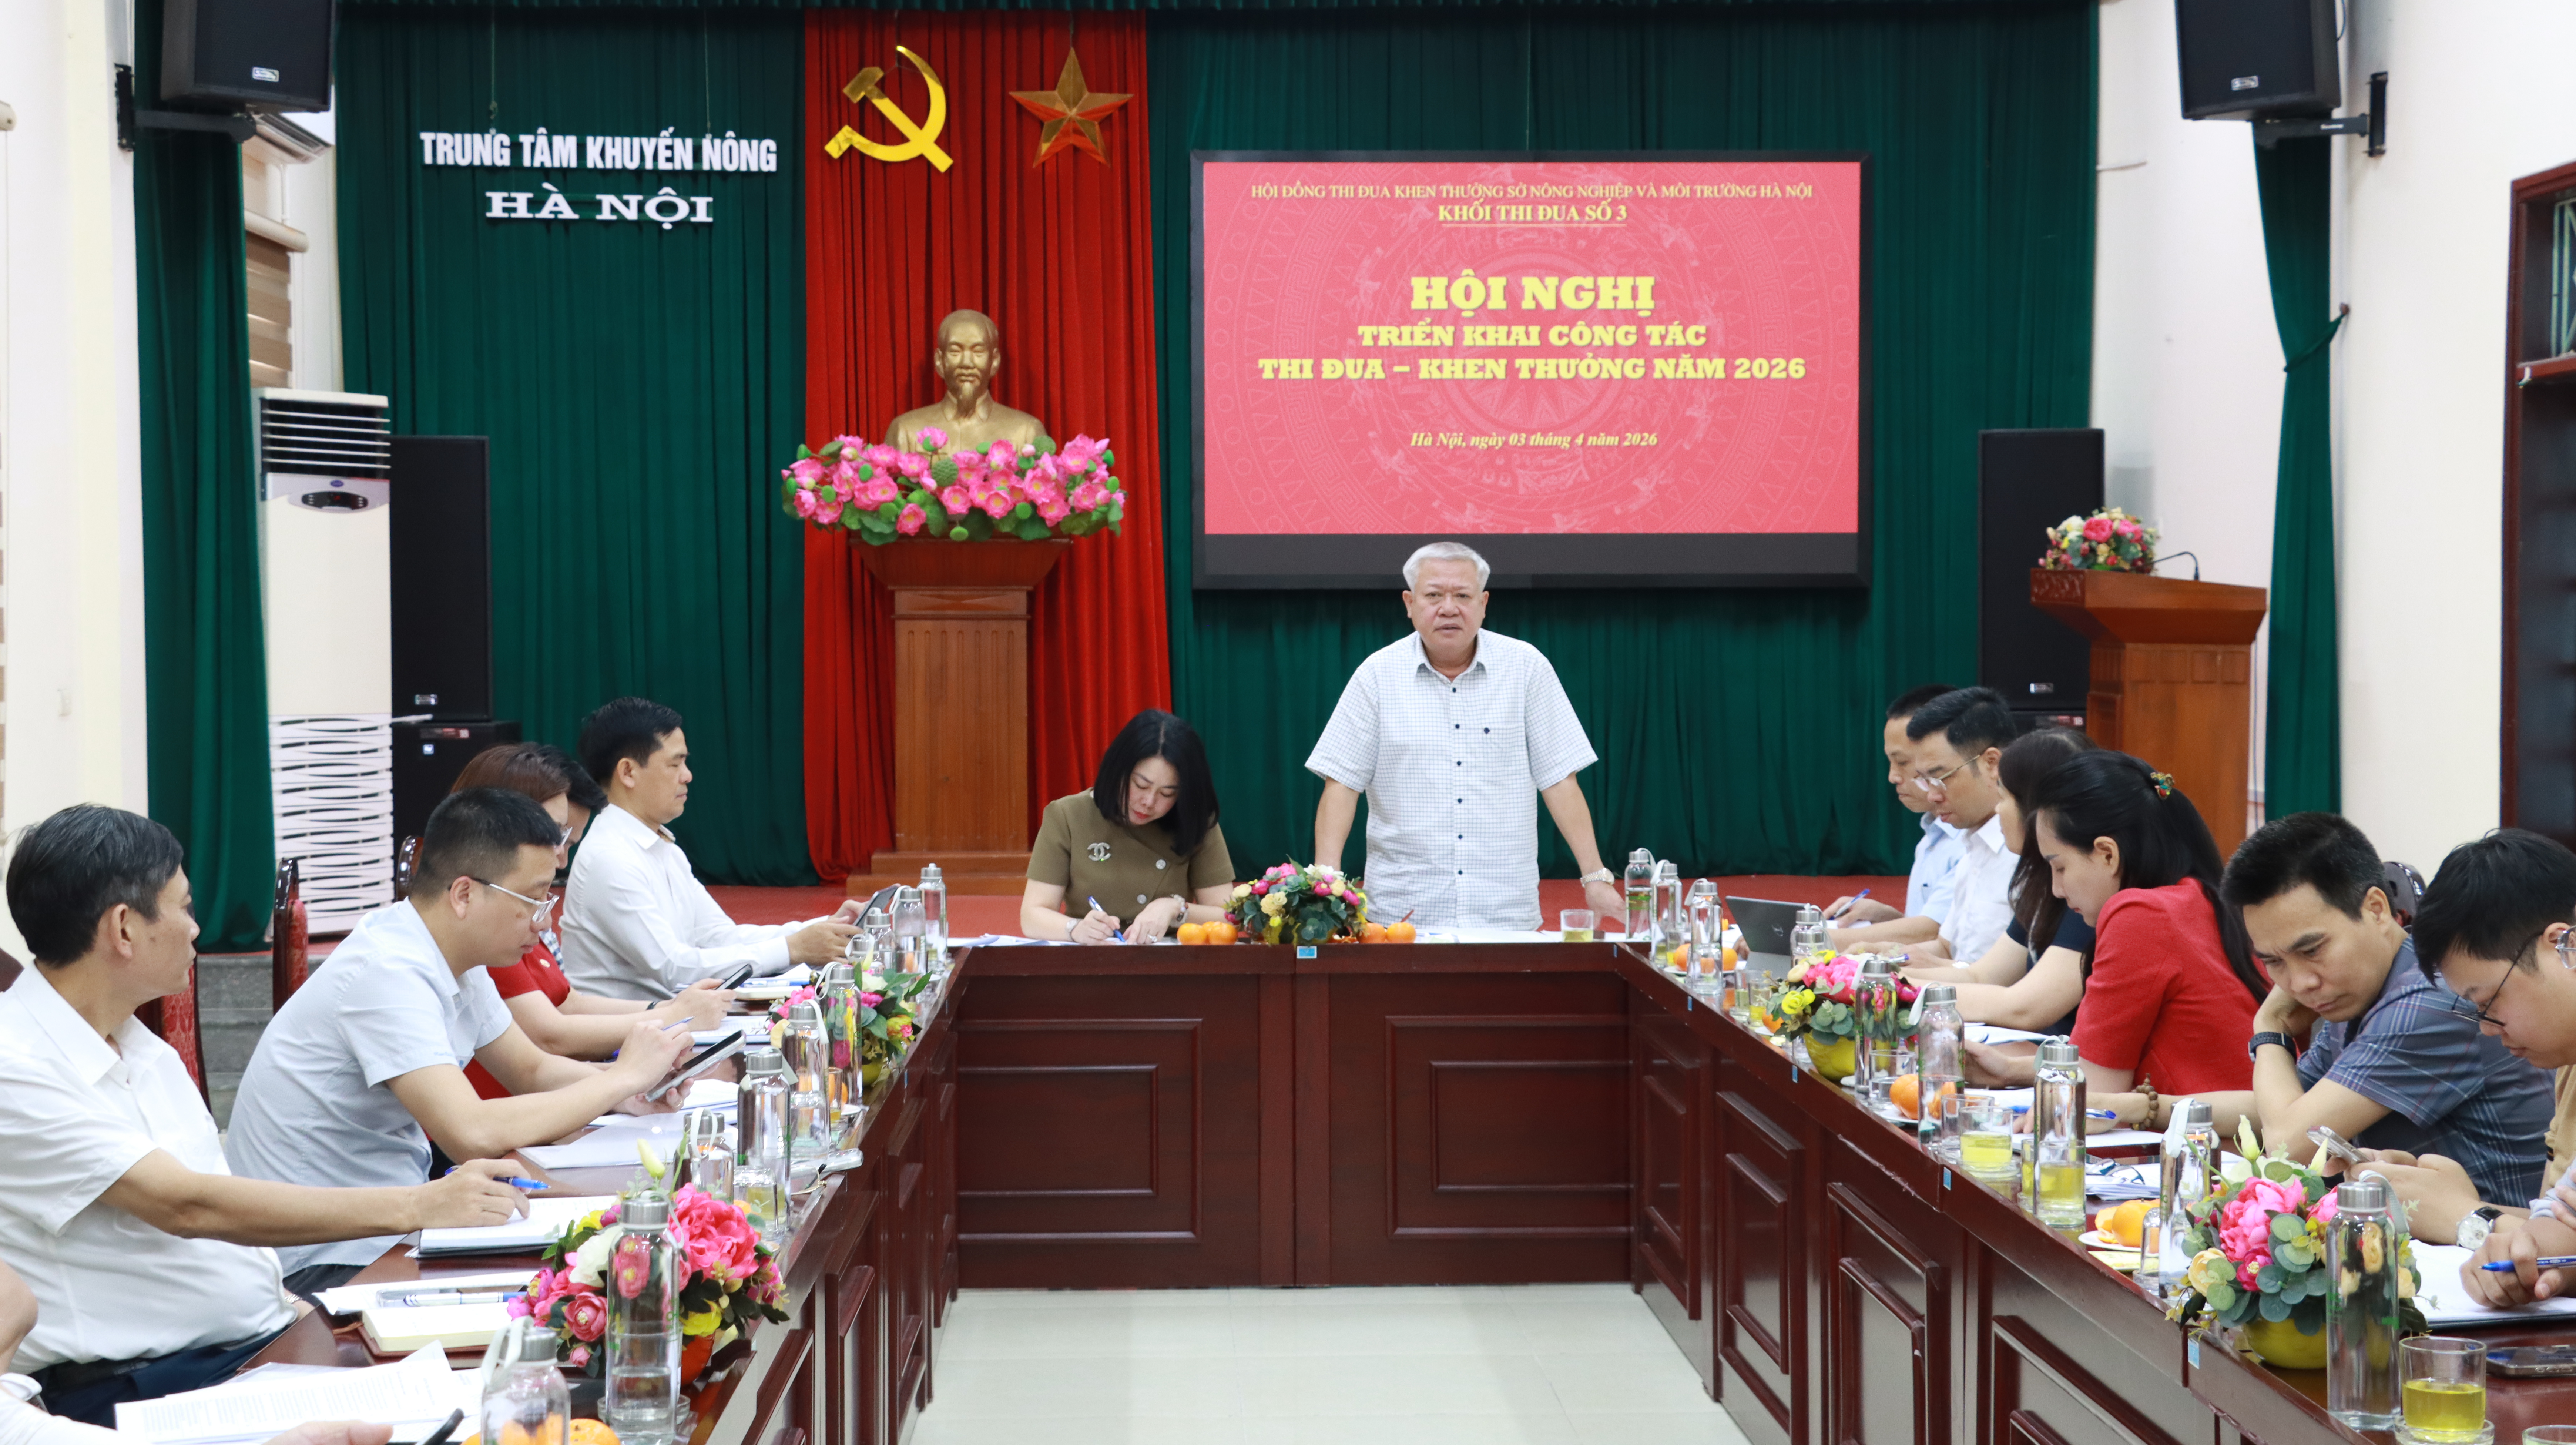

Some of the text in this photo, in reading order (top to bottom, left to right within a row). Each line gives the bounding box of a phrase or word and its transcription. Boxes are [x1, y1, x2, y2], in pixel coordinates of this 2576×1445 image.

[420, 127, 777, 172] TRUNG TÂM KHUYẾN NÔNG
[486, 182, 713, 230] HÀ NỘI
[1252, 182, 1278, 200] HỘI
[1329, 185, 1354, 198] THI
[1358, 185, 1391, 198] ĐUA
[1395, 185, 1436, 198] KHEN
[1439, 182, 1503, 198] THƯỞNG
[1507, 182, 1527, 198] SỞ
[1530, 182, 1573, 198] NÔNG
[1577, 182, 1633, 201] NGHIỆP
[1636, 182, 1657, 198] VÀ
[1661, 182, 1690, 198] MÔI
[1694, 182, 1757, 198] TRƯỜNG
[1760, 182, 1782, 198] HÀ
[1786, 182, 1812, 200] NỘI
[1439, 198, 1627, 221] KHỐI THI ĐUA SỐ 3
[1410, 268, 1655, 318] HỘI NGHỊ
[1357, 317, 1707, 347] TRIỂN KHAI CÔNG TÁC
[1258, 358, 1314, 380] THI
[1321, 358, 1386, 380] ĐUA
[1418, 358, 1507, 380] KHEN
[1515, 352, 1646, 380] THƯỞNG
[1653, 353, 1726, 380] NĂM
[1734, 358, 1806, 380] 2026
[1410, 432, 1658, 450] Hà Nội, ngày 03 tháng 4 năm 2026
